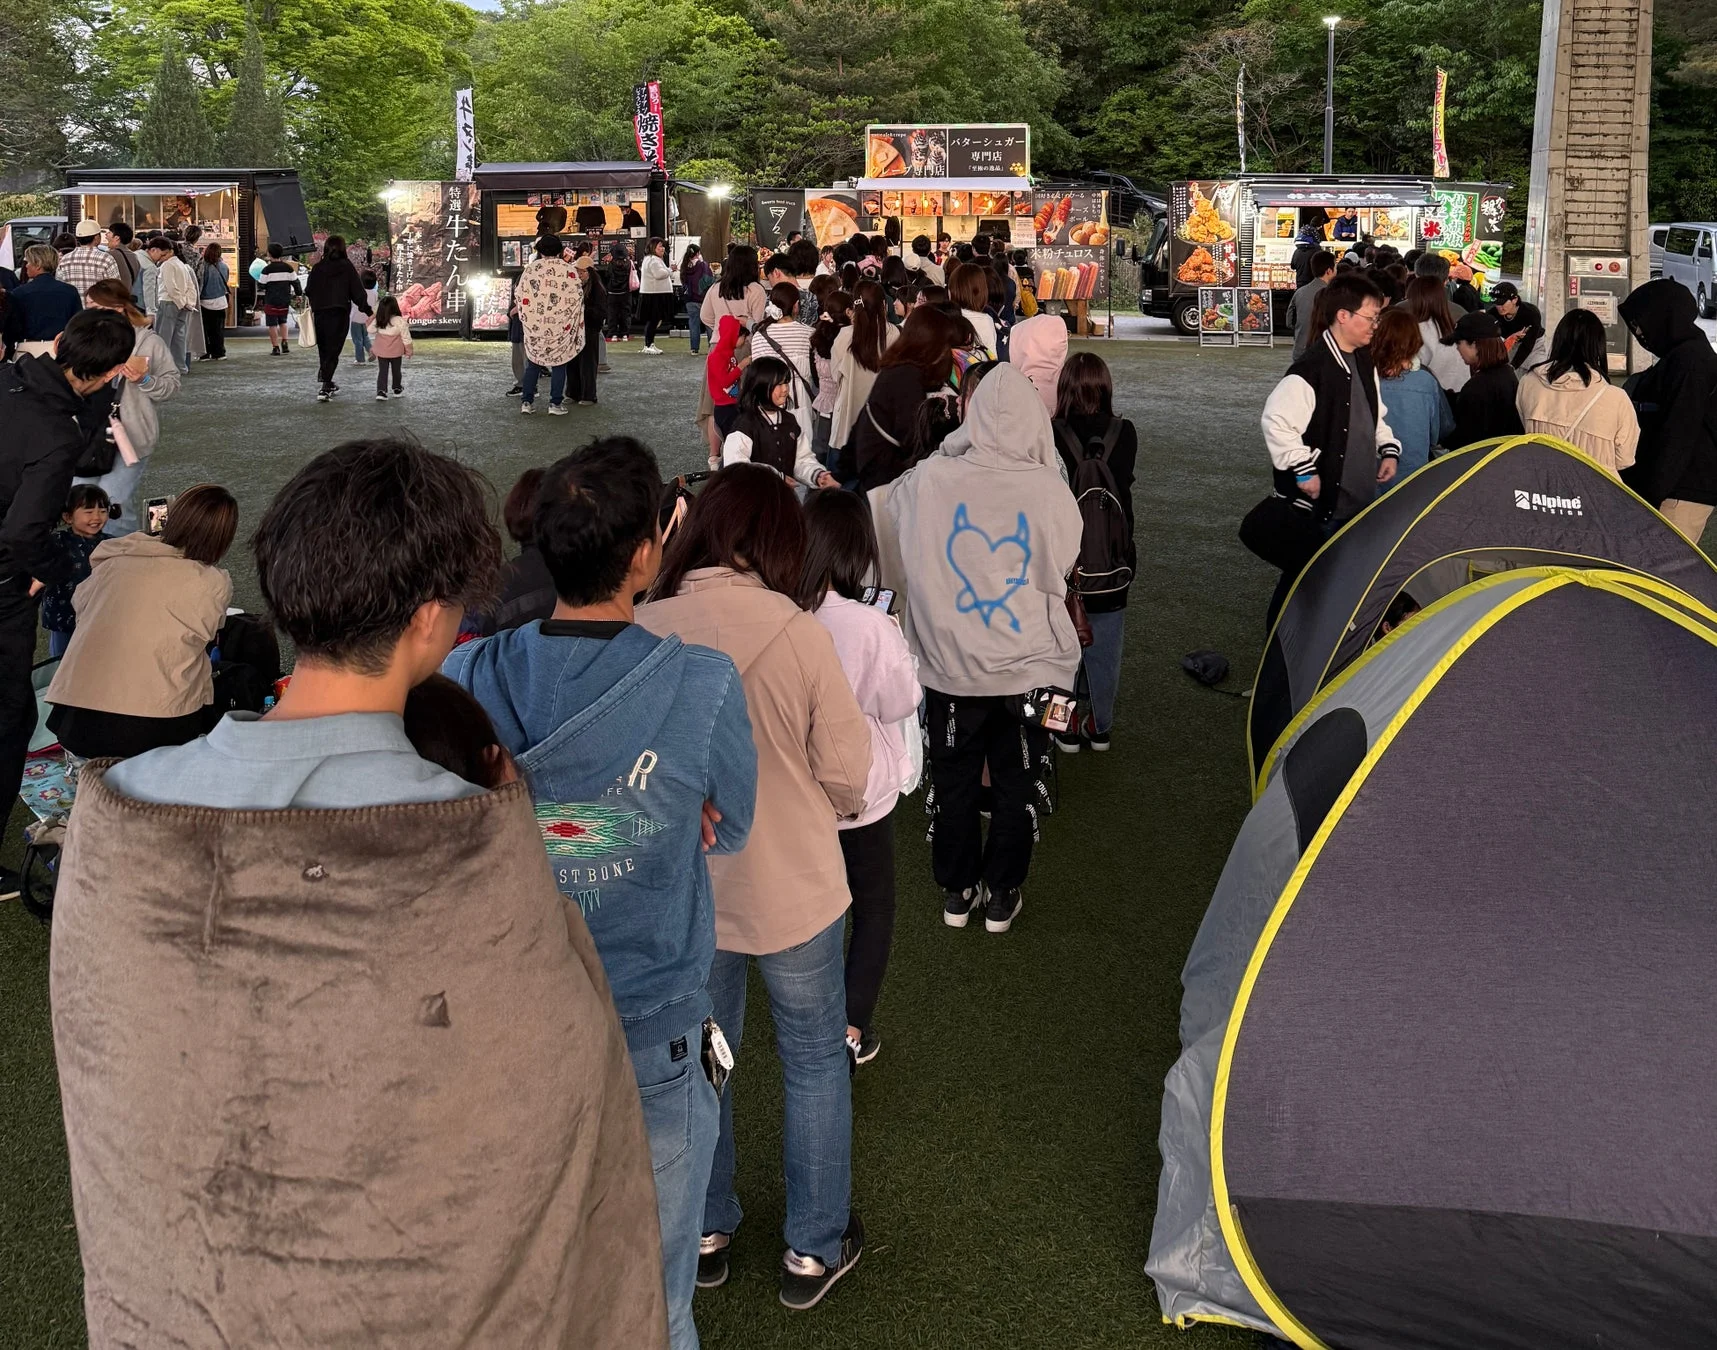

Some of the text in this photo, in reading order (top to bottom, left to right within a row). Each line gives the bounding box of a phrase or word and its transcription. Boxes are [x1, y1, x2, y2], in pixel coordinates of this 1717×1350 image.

[950, 136, 1026, 147] バターシュガー
[970, 151, 1003, 162] 専門店
[870, 164, 945, 177] クレープ専門店
[1423, 220, 1441, 238] 氷
[1030, 248, 1093, 260] 米粉チュロス
[409, 317, 437, 325] tongue
[1532, 493, 1582, 509] Alpine
[587, 857, 636, 884] BONE
